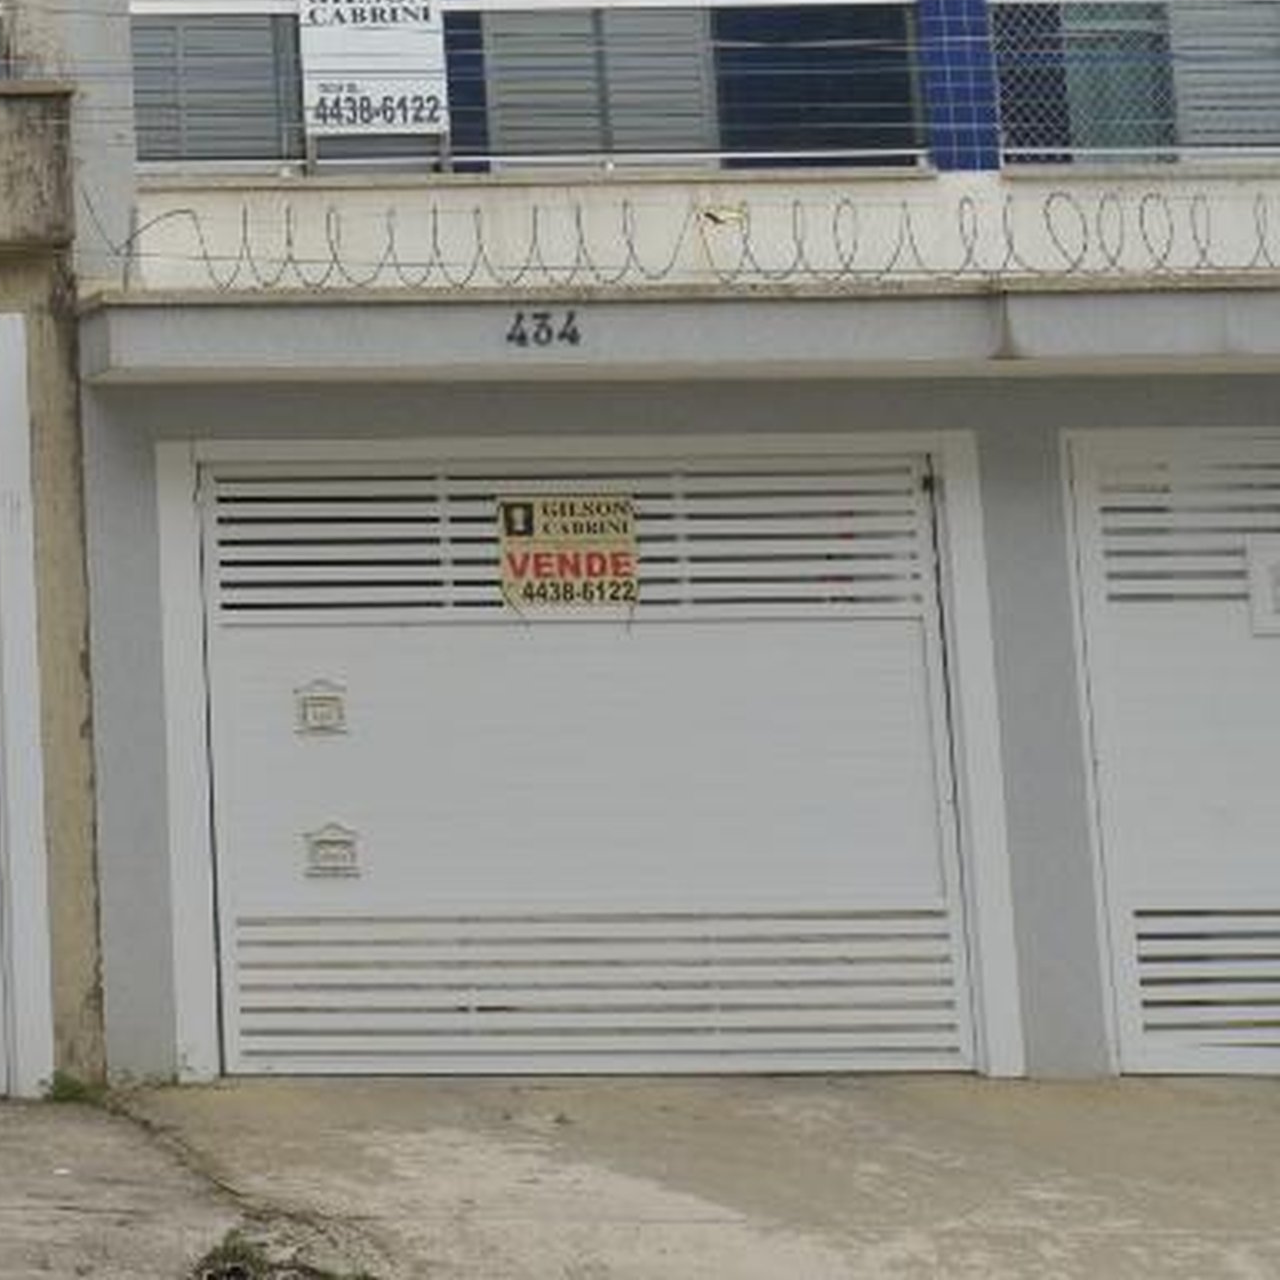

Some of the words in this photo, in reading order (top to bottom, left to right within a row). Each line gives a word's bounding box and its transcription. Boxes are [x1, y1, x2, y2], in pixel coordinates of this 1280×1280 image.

[308, 6, 430, 25] CABRINI
[315, 94, 441, 124] 4438-6122
[506, 310, 581, 347] 434
[542, 500, 633, 518] GILSON
[542, 520, 629, 535] CABRINI
[506, 550, 635, 579] VENDE
[522, 580, 637, 602] 4438-6122
